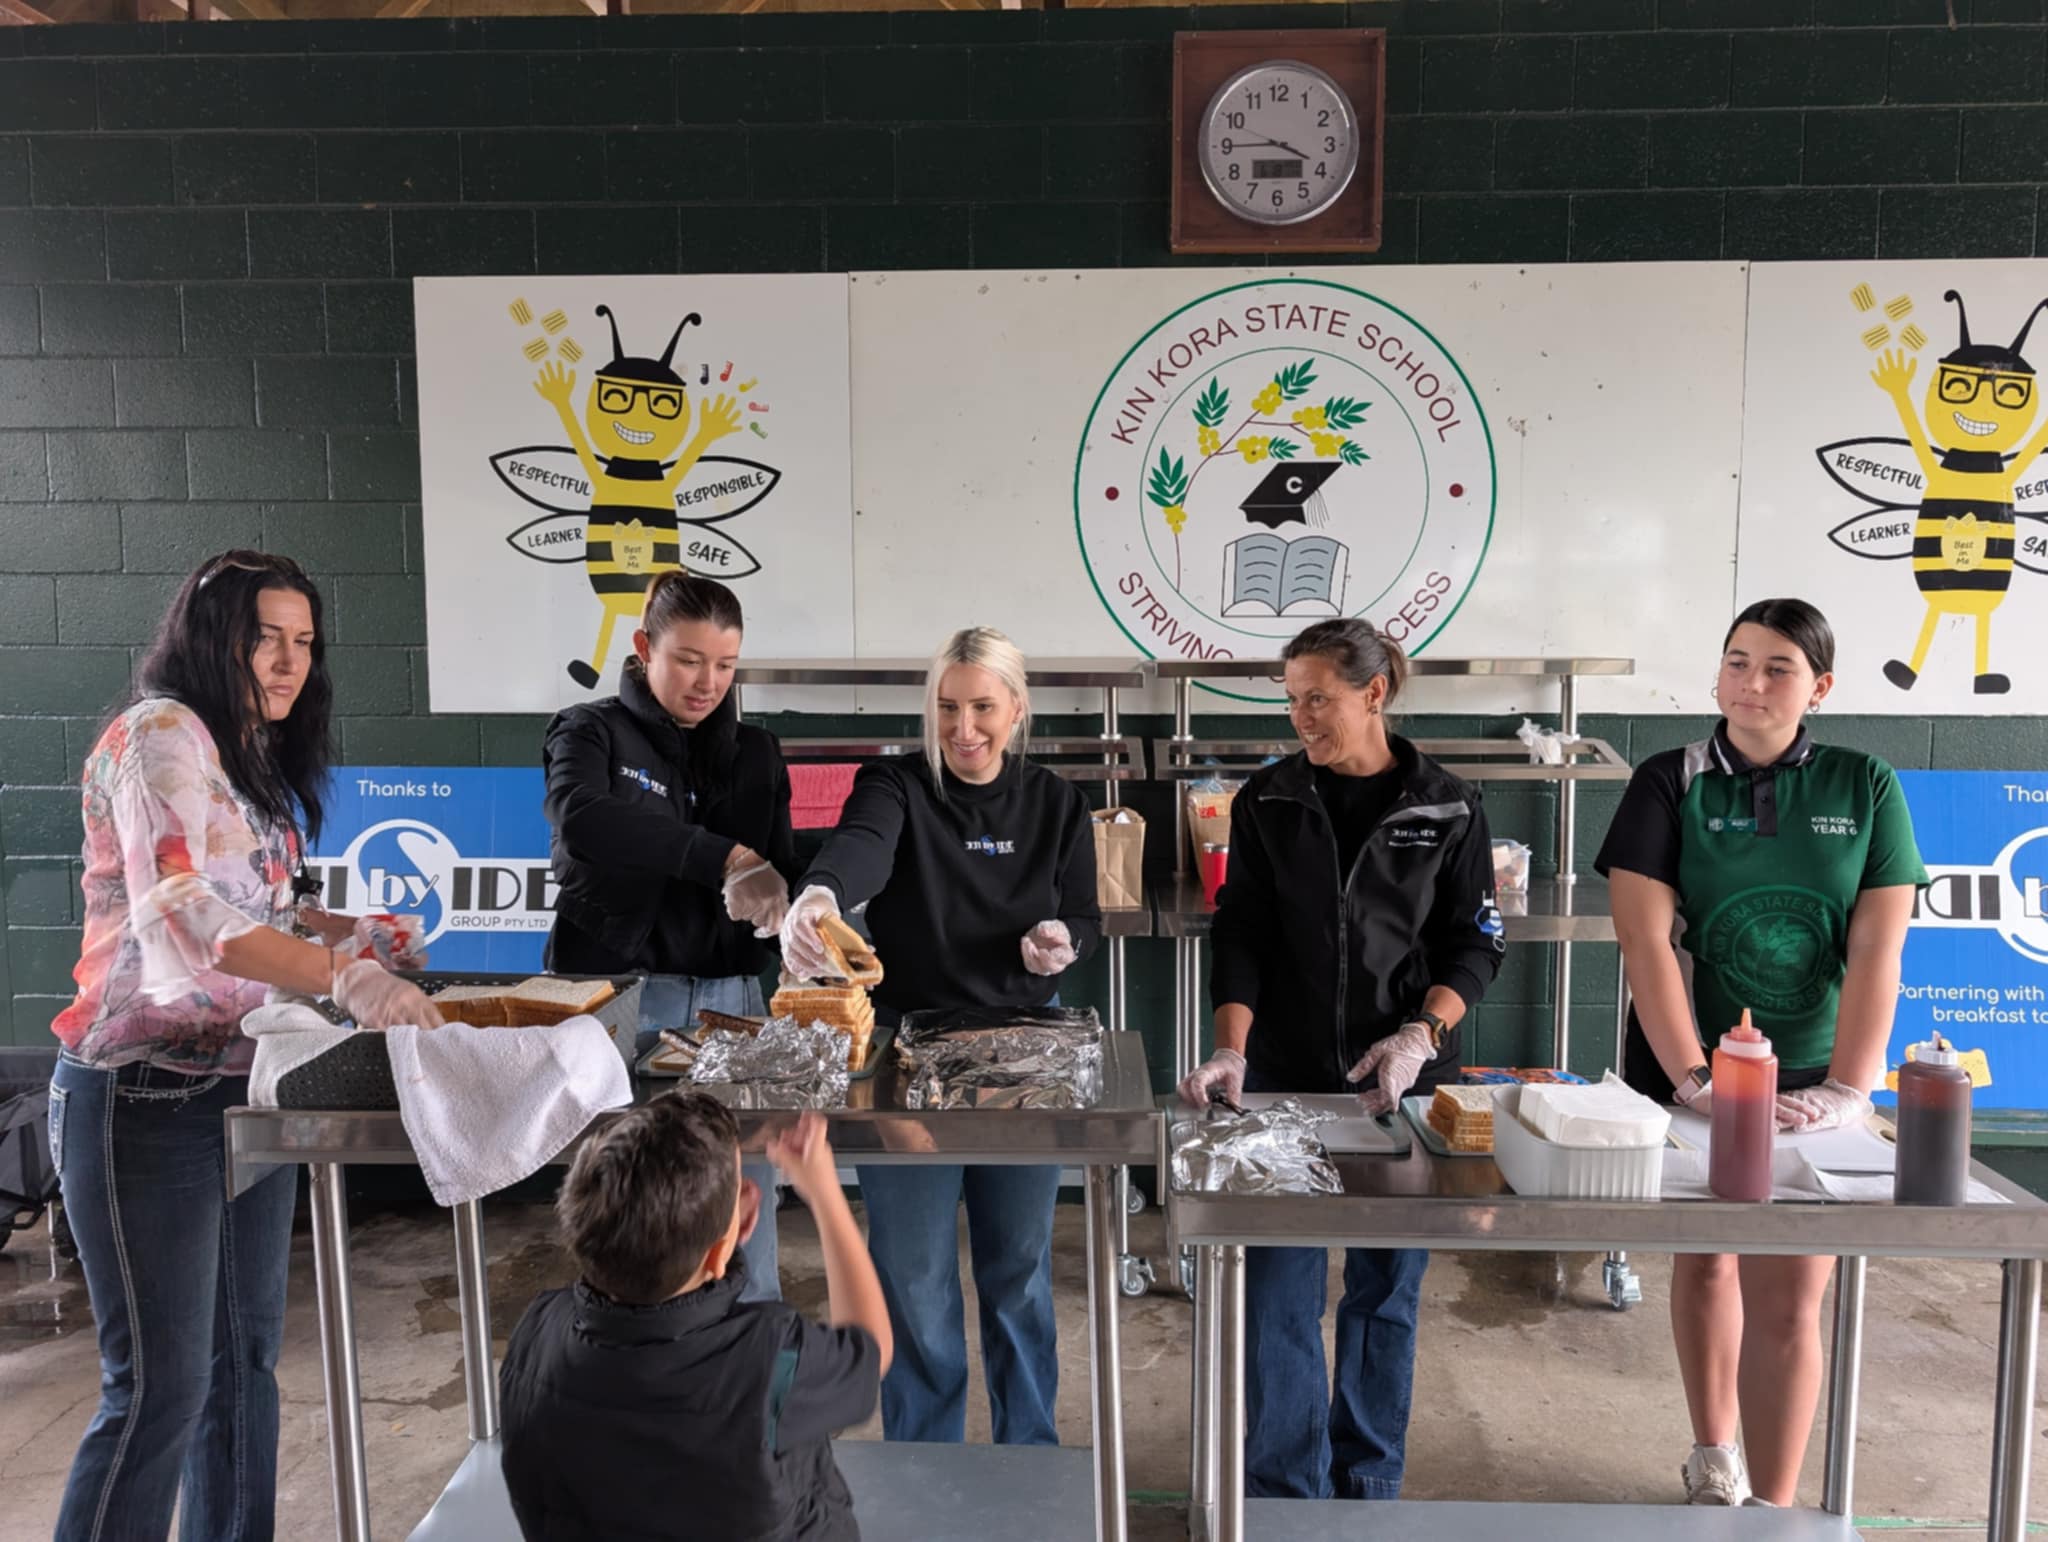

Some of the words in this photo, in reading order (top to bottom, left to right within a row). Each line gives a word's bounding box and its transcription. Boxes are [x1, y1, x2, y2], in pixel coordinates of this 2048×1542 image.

[1247, 92, 1261, 110] 11
[1269, 85, 1289, 101] 12
[1301, 92, 1308, 108] 1
[1227, 112, 1245, 129] 10
[1318, 111, 1329, 127] 2
[1221, 138, 1233, 155] 9
[1324, 137, 1336, 153] 3
[1229, 164, 1240, 180] 8
[1315, 162, 1327, 178] 4
[1247, 183, 1259, 200] 7
[1272, 190, 1283, 206] 6
[1298, 182, 1310, 199] 5
[1111, 387, 1155, 445] KIN
[1148, 318, 1239, 388] KORA
[1245, 304, 1351, 337] STATE
[1357, 324, 1461, 443] SCHOOL
[508, 461, 591, 497] RESPECTFUL
[1836, 453, 1923, 489] RESPECTFUL
[676, 471, 766, 507] RESPONSIBLE
[1286, 476, 1303, 494] C
[528, 528, 583, 548] LEARNER
[1850, 522, 1911, 544] LEARNER
[687, 542, 731, 566] SAFE
[357, 780, 427, 797] Thanks
[432, 781, 451, 797] to
[1829, 817, 1856, 825] KORA
[1811, 825, 1847, 835] YEAR
[1850, 827, 1858, 836] 6
[368, 868, 440, 908] by
[1752, 896, 1801, 912] STATE
[451, 915, 501, 928] GROUP
[504, 918, 525, 927] PTY
[528, 919, 548, 928] LTD
[2004, 986, 2045, 1001] with
[1932, 1006, 2027, 1024] breakfast
